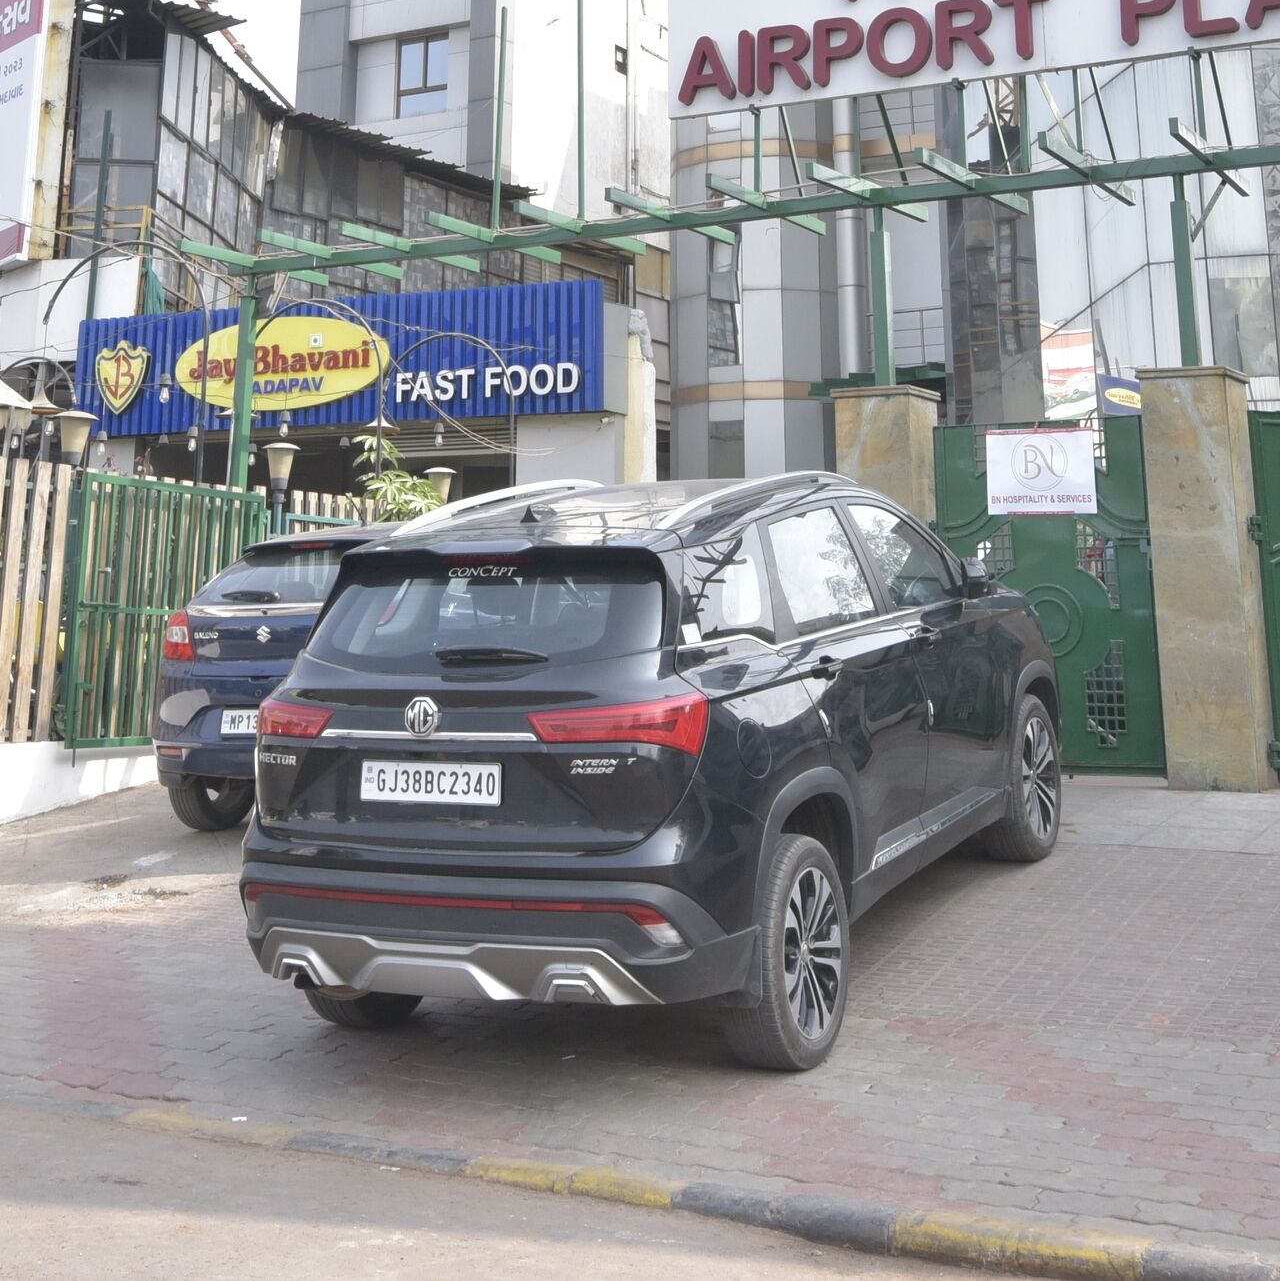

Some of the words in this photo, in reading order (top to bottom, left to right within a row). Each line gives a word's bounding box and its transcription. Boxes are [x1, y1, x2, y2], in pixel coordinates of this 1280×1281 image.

[189, 350, 236, 384] Jay
[253, 340, 371, 375] Bhavani
[252, 376, 324, 395] ADAPAV
[395, 368, 475, 403] FAST
[484, 362, 581, 398] FOOD
[991, 495, 1002, 504] BN
[1003, 494, 1049, 504] HOSPITALITY
[1057, 494, 1092, 503] SERVICES
[448, 565, 517, 577] CONCEPT
[407, 701, 435, 733] MG
[259, 752, 297, 767] HECTOR
[570, 766, 616, 775] INSIDE
[377, 768, 496, 797] GJ38BC2340
